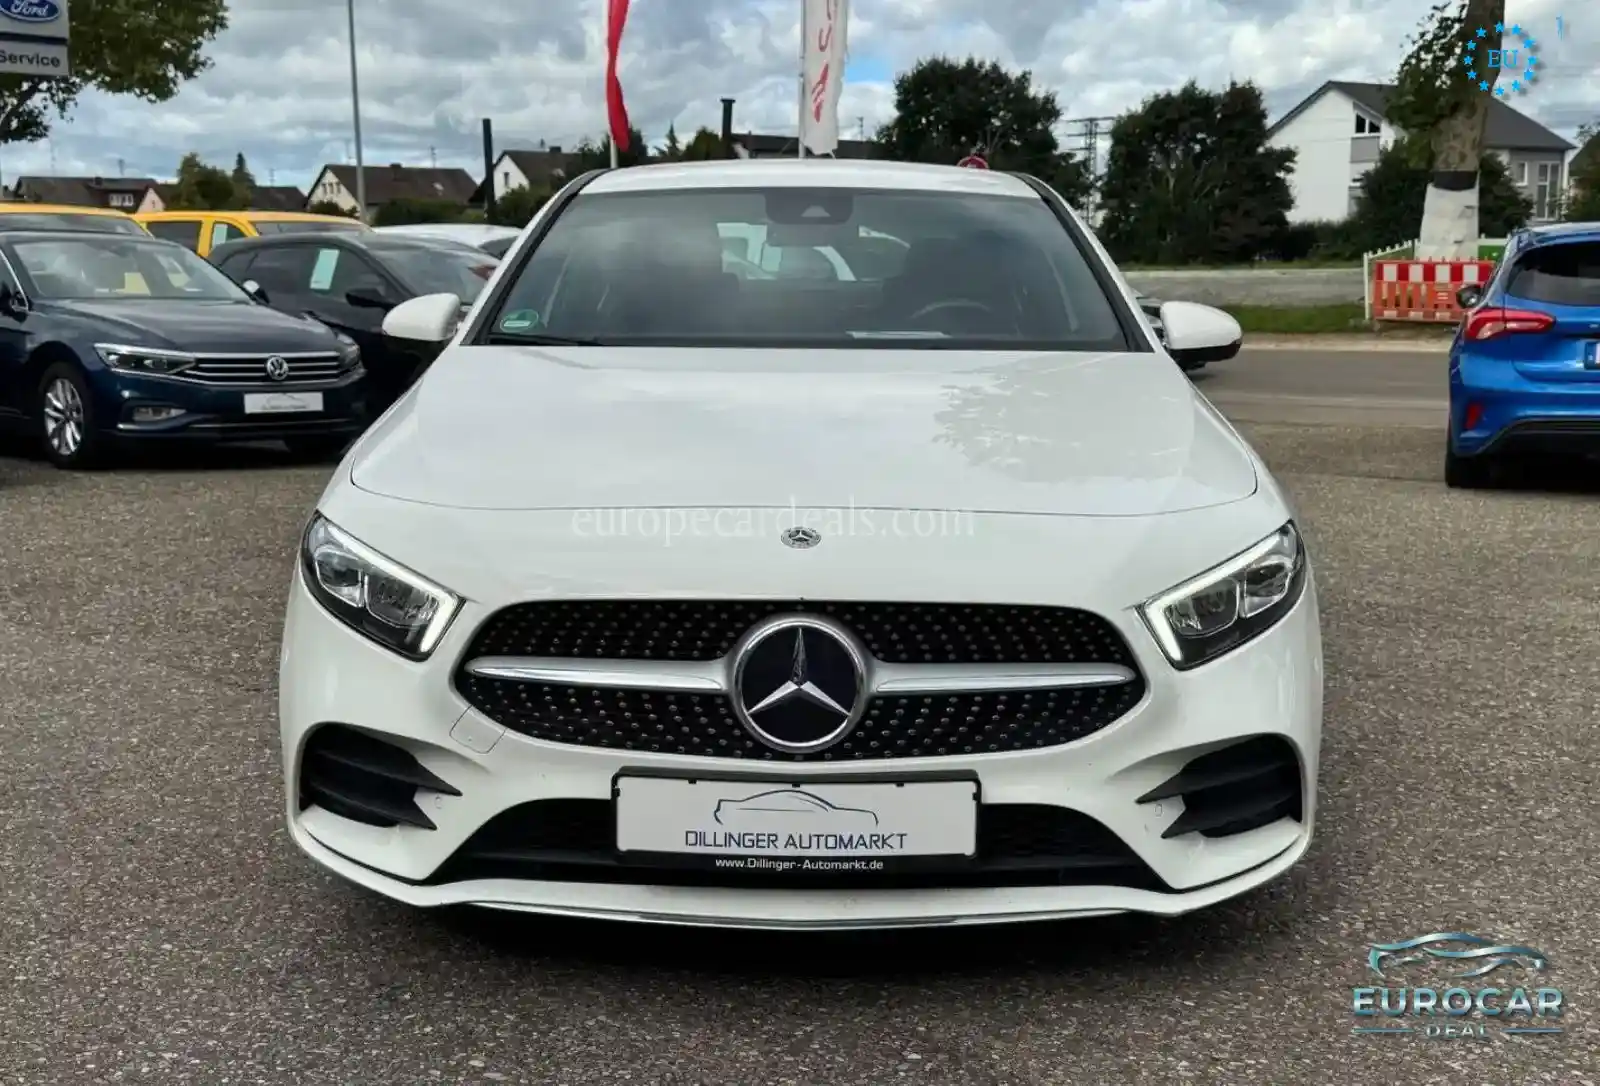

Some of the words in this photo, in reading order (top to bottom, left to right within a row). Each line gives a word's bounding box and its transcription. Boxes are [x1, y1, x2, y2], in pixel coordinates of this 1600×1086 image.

[10, 0, 49, 17] Ford
[0, 49, 61, 68] Service
[685, 830, 779, 849] DILLINGER
[783, 833, 908, 850] AUTOMARKT
[715, 857, 884, 871] www.Dillinger-Automarkt.de
